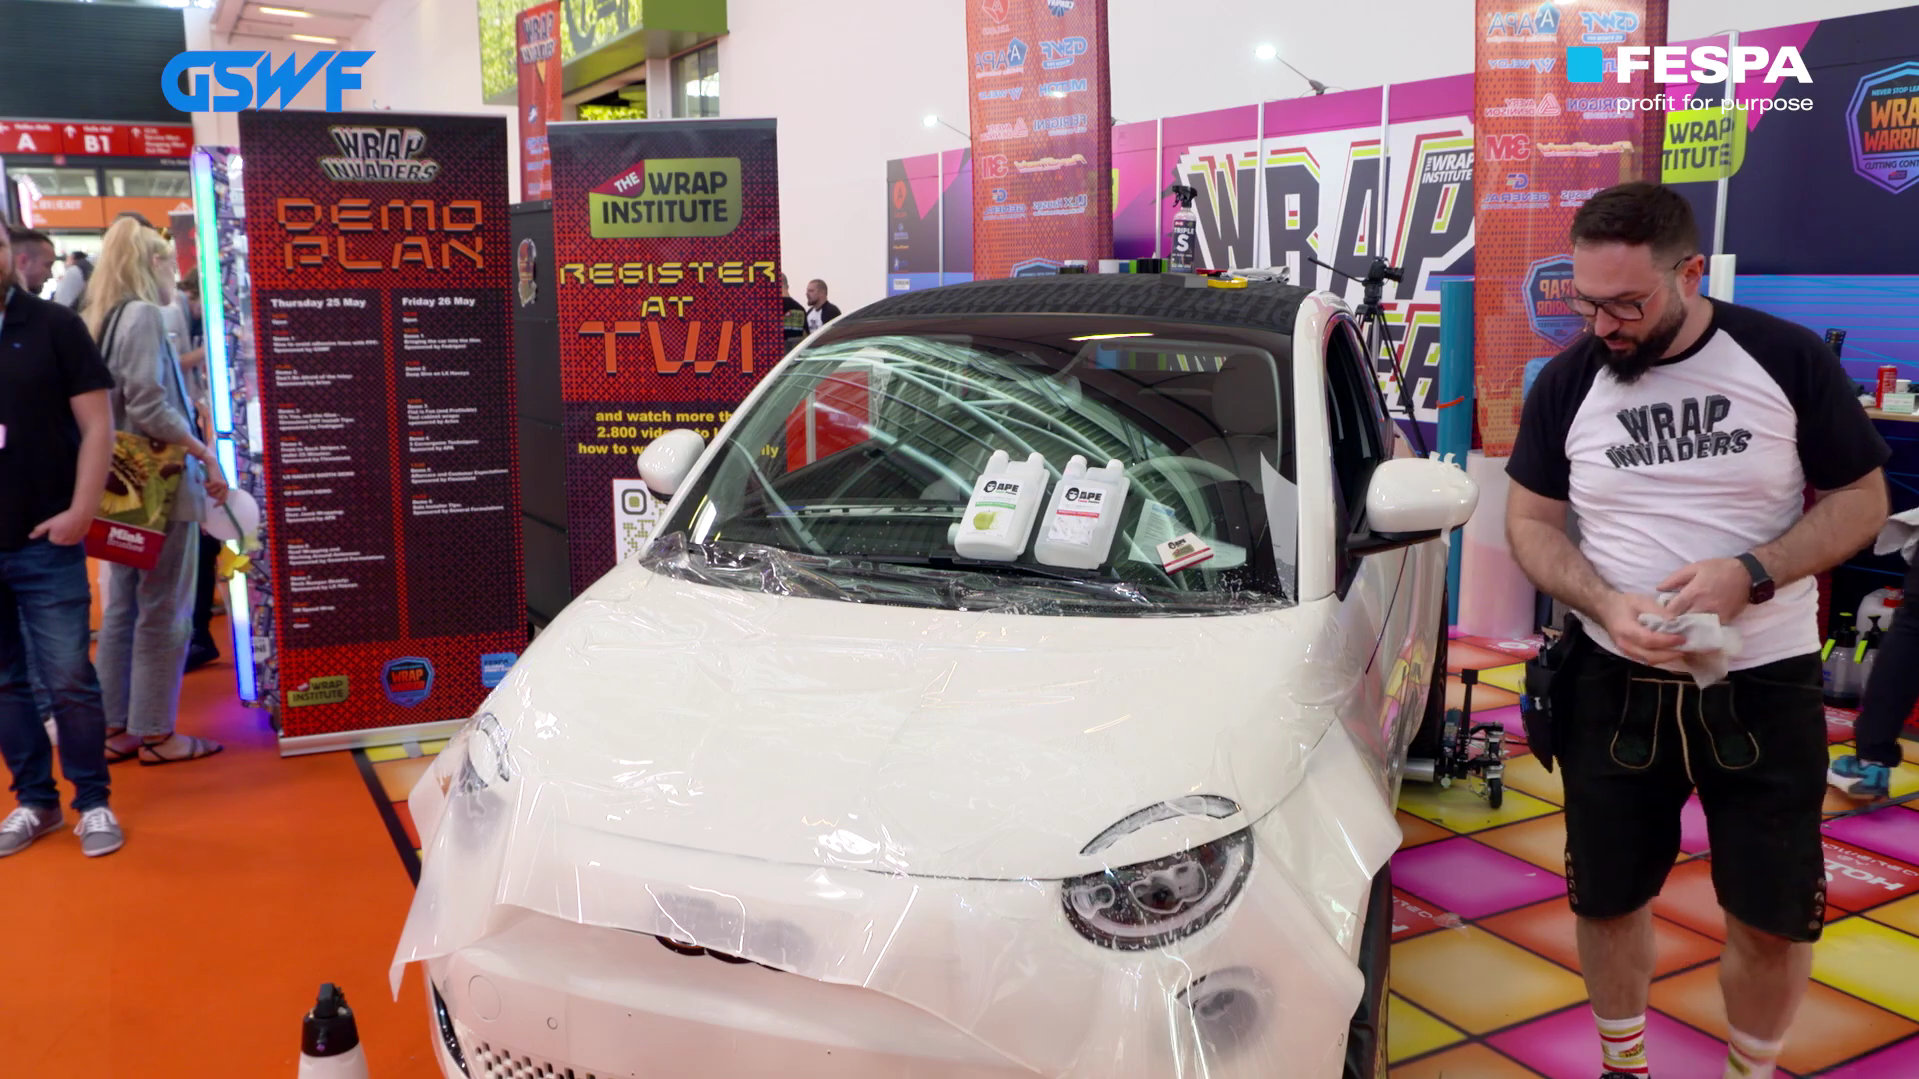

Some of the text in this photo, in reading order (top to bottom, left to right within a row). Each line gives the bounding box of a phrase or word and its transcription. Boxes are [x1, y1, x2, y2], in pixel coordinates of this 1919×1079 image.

[1872, 88, 1892, 96] NEVER
[1893, 86, 1909, 95] STOP
[1871, 97, 1919, 129] WRA
[1669, 117, 1735, 145] WRAP
[1863, 127, 1919, 152] WARRI
[16, 132, 37, 152] A
[83, 134, 111, 153] B1
[331, 126, 426, 161] WRAP
[1432, 152, 1475, 172] WRAP
[1663, 142, 1732, 171] TITUTE
[1865, 158, 1919, 170] CUTTING CONT
[320, 157, 441, 182] INVADERS
[1422, 169, 1473, 184] INSTITUTE
[614, 172, 640, 193] THE
[648, 171, 728, 195] WRAP
[277, 198, 483, 232] DEMO
[602, 199, 729, 224] INSTITUTE
[283, 234, 484, 271] PLAN
[1176, 234, 1190, 252] S
[560, 262, 775, 285] REGISTER
[270, 298, 367, 309] Thursday 25 May
[402, 297, 476, 308] Friday 26 May
[641, 296, 694, 318] AT
[578, 320, 755, 373] TWI
[595, 410, 735, 423] and watch more th
[1616, 394, 1731, 444] WRAP
[597, 426, 637, 439] 2.800
[578, 443, 628, 454] how to
[1605, 428, 1753, 469] INVADERS
[996, 482, 1020, 493] APE
[1079, 491, 1103, 501] APE
[292, 688, 343, 702] INSTITUTE
[311, 680, 344, 691] WRAP
